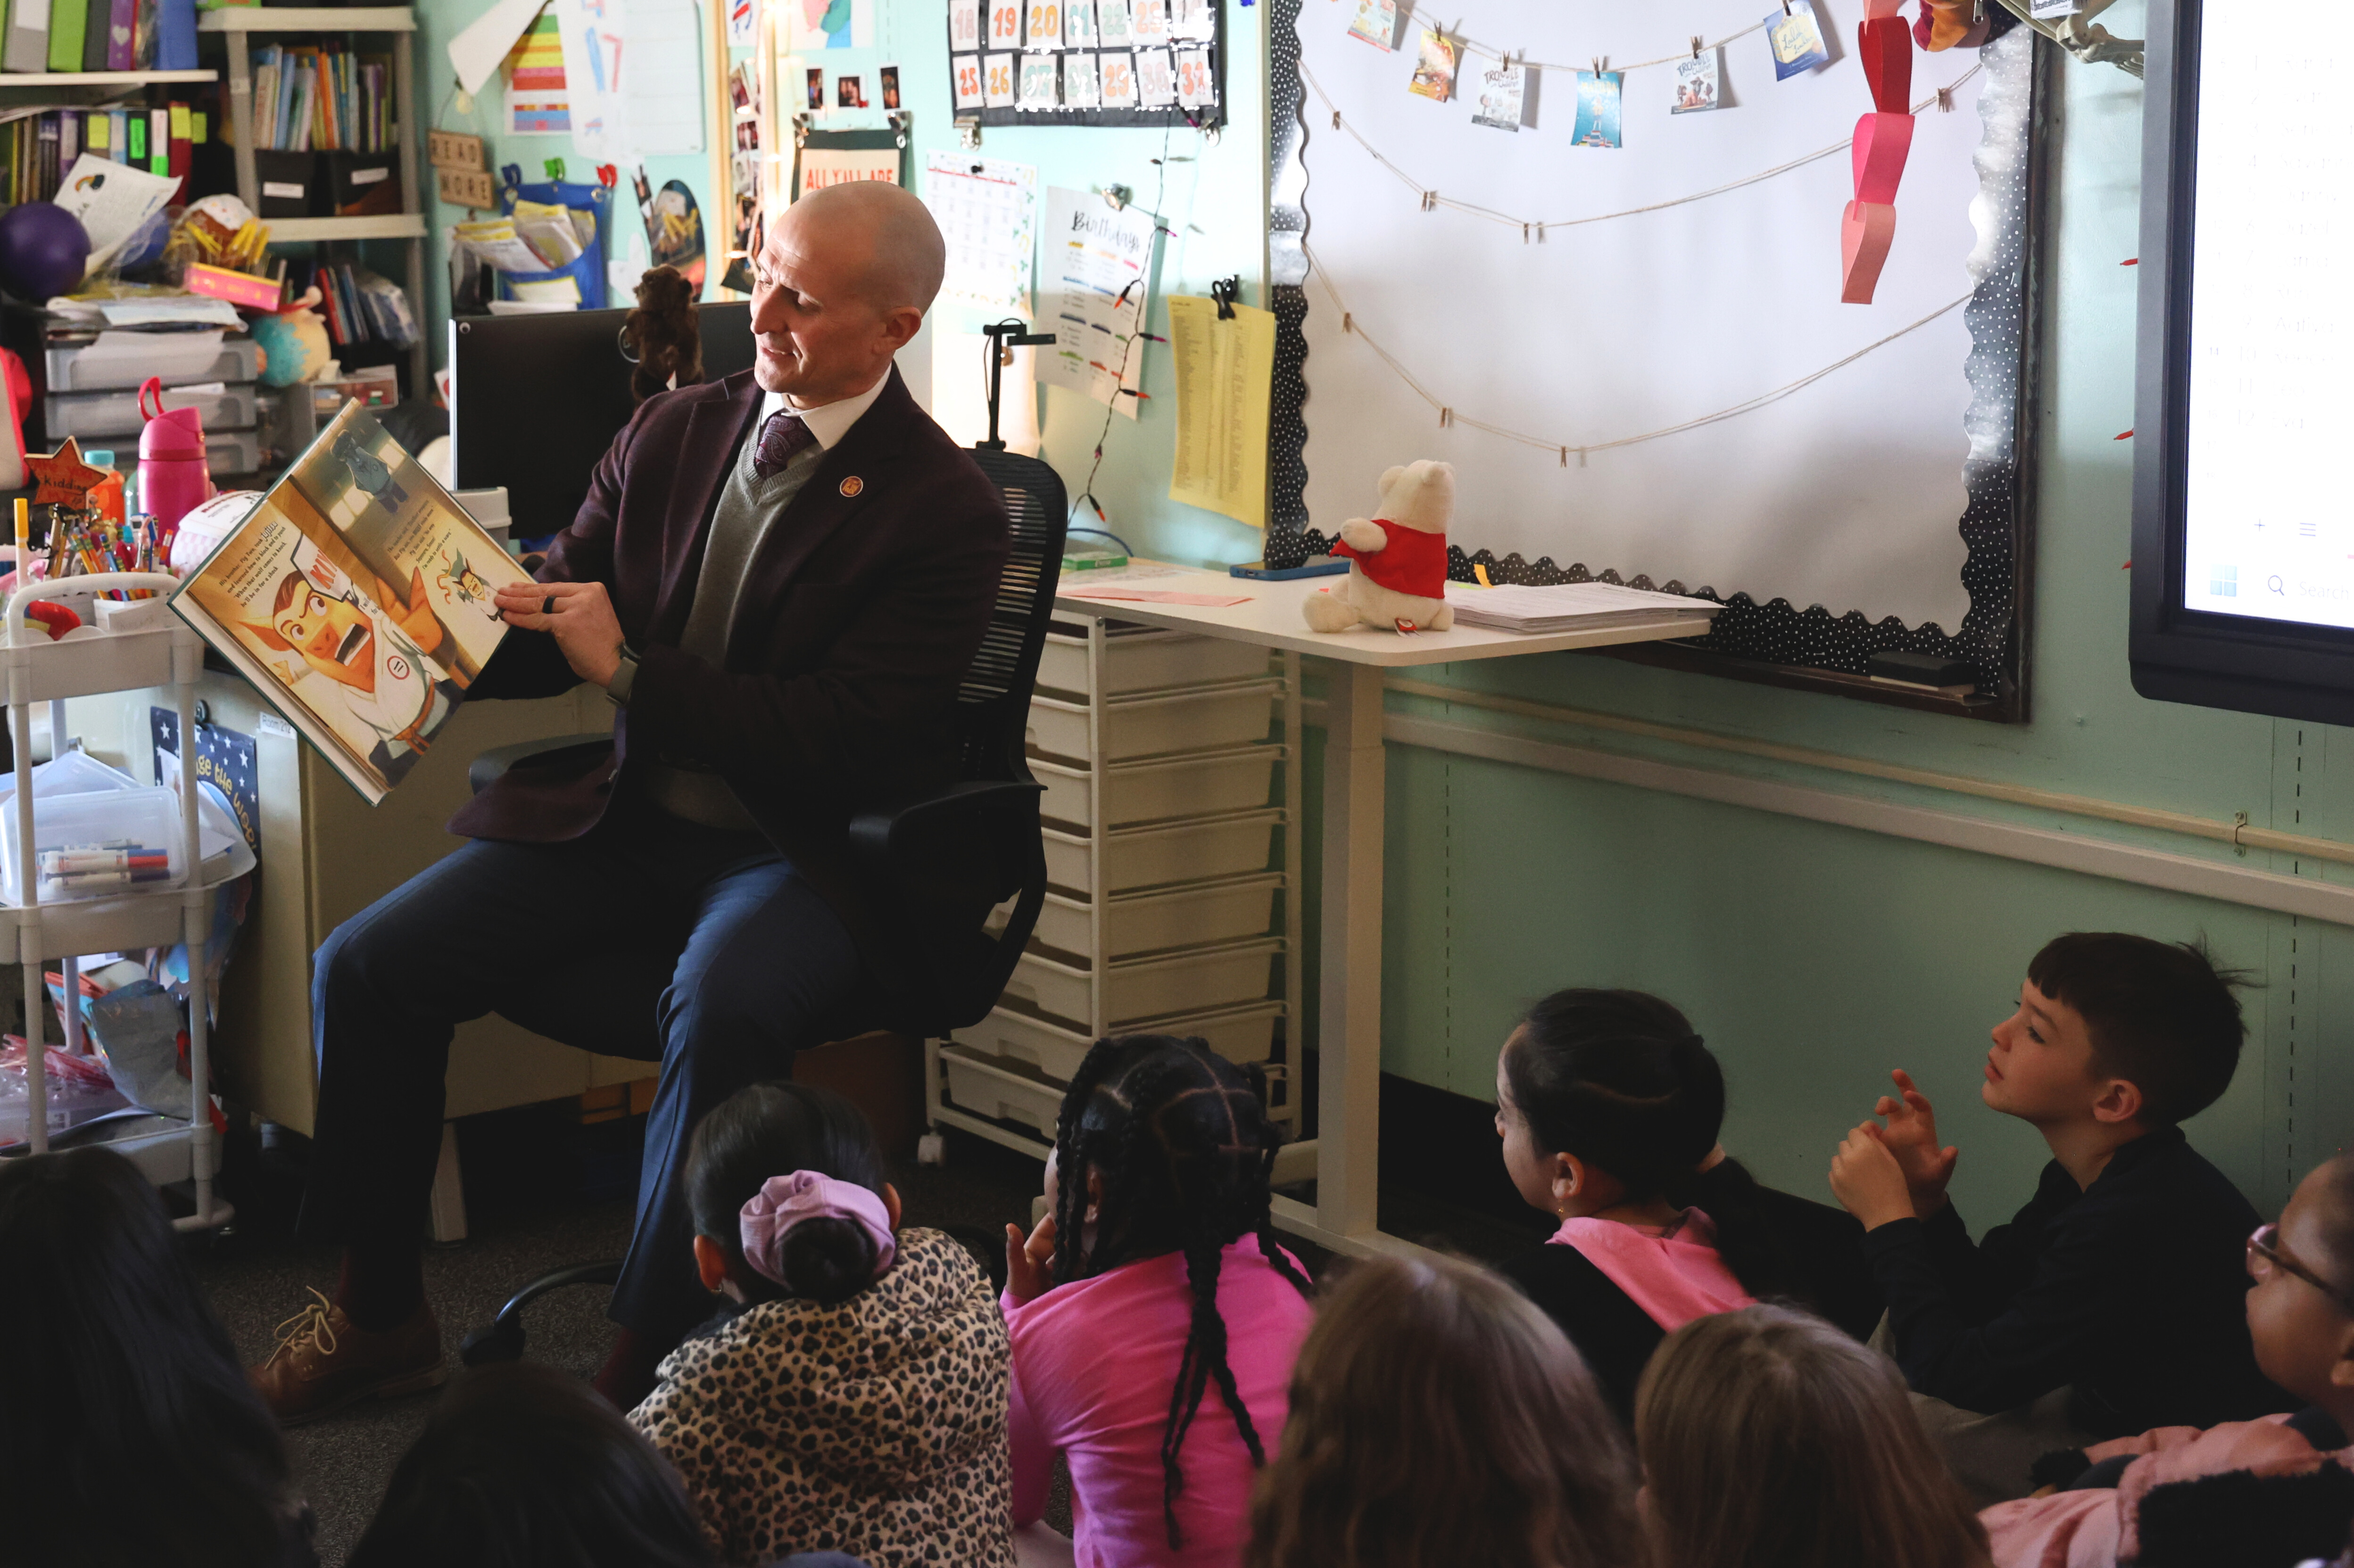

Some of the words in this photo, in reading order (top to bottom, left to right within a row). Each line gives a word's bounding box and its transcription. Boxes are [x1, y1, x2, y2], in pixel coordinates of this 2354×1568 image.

[956, 9, 974, 40] 18
[994, 7, 1016, 37] 19
[1030, 5, 1058, 37] 20
[1102, 4, 1126, 35] 22
[960, 67, 978, 96] 25
[990, 66, 1009, 94] 26
[1025, 65, 1052, 96] 27
[1104, 64, 1129, 96] 29
[1143, 63, 1169, 94] 30
[1181, 62, 1205, 95] 31
[430, 138, 477, 163] READ
[441, 174, 487, 200] MORE
[806, 169, 827, 189] ALL
[1071, 211, 1140, 254] Birthdays
[240, 555, 249, 564] Pig
[255, 538, 263, 547] took
[426, 554, 434, 565] ready
[227, 584, 235, 593] and
[234, 568, 249, 586] learned
[249, 561, 257, 570] how
[260, 545, 269, 557] block
[246, 577, 256, 586] that
[255, 568, 264, 578] wolf
[263, 557, 274, 568] comes
[2298, 580, 2349, 601] Search
